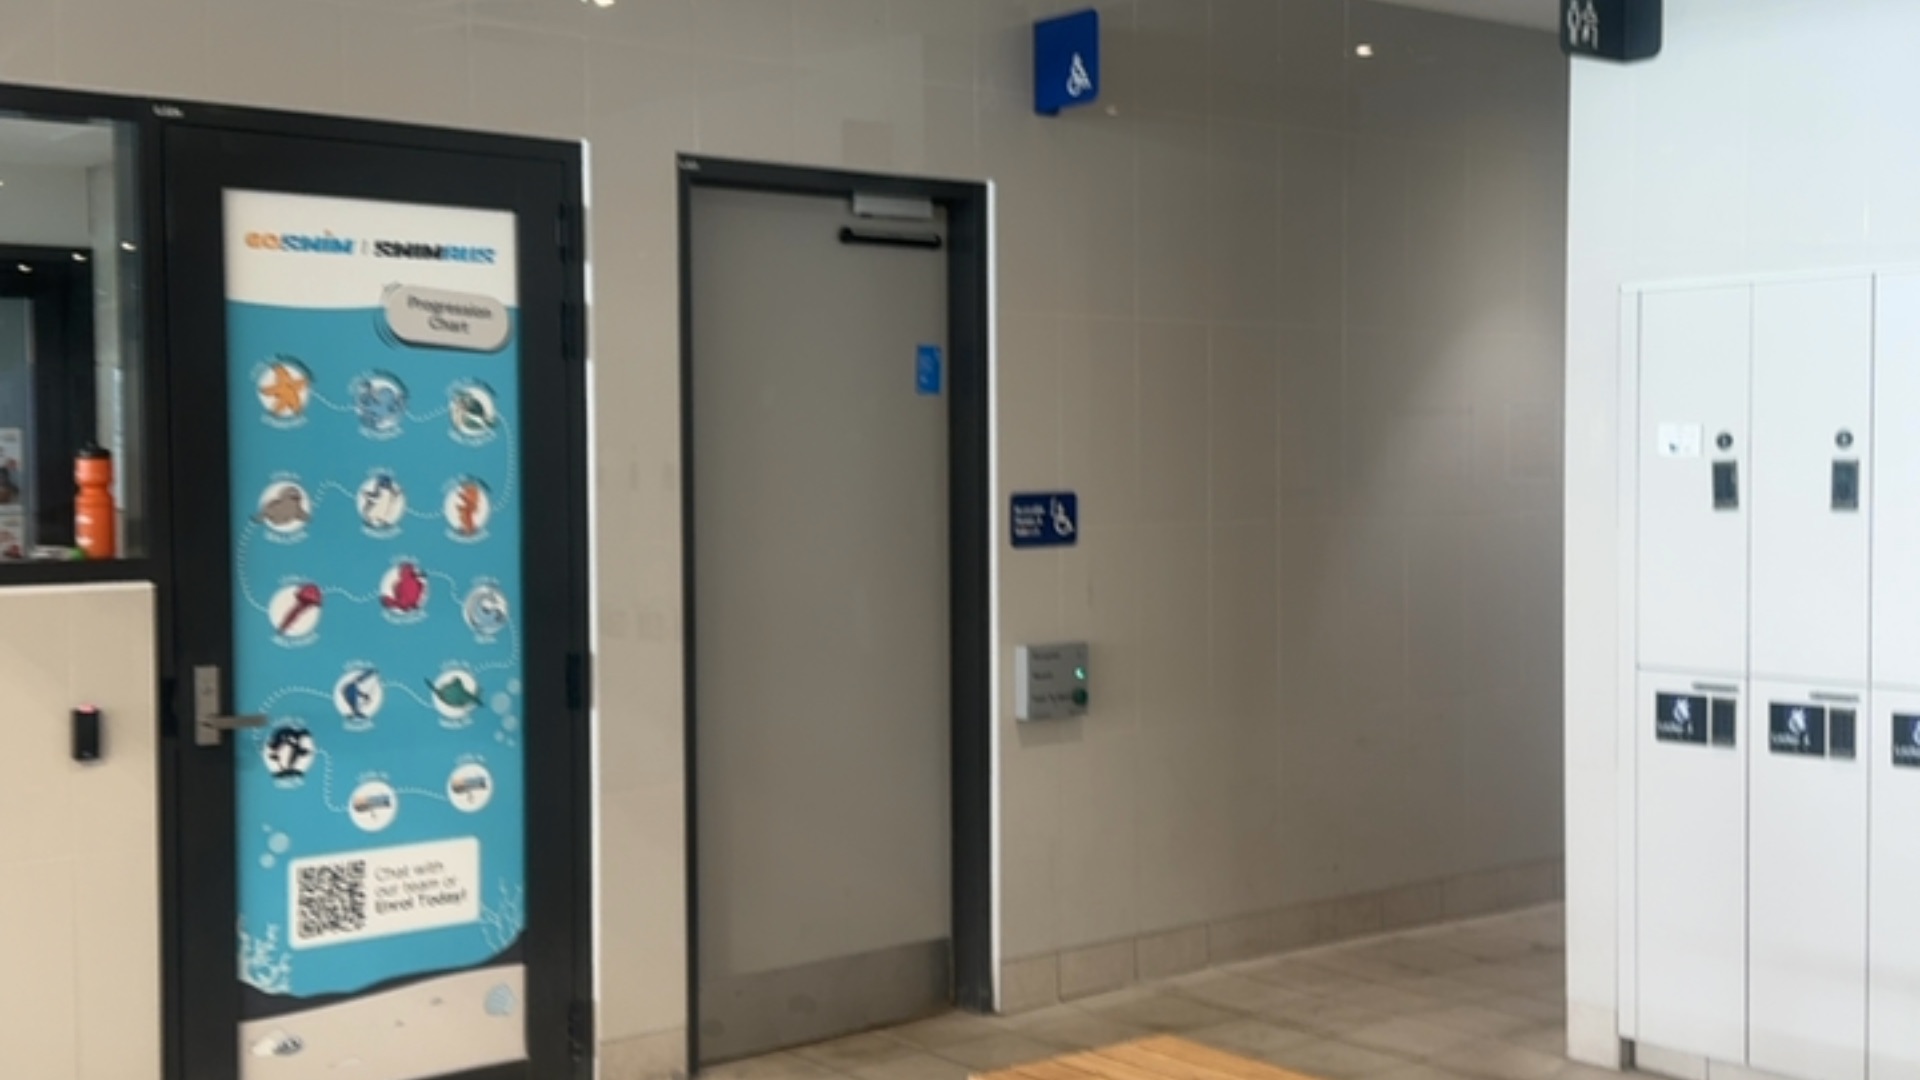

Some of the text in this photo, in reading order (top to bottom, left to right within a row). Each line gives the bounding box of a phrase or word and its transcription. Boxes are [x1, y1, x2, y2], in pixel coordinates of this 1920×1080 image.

[407, 295, 491, 319] Progression
[428, 314, 470, 334] Chart
[375, 862, 443, 882] Chat with
[376, 885, 398, 897] our
[403, 880, 438, 895] team
